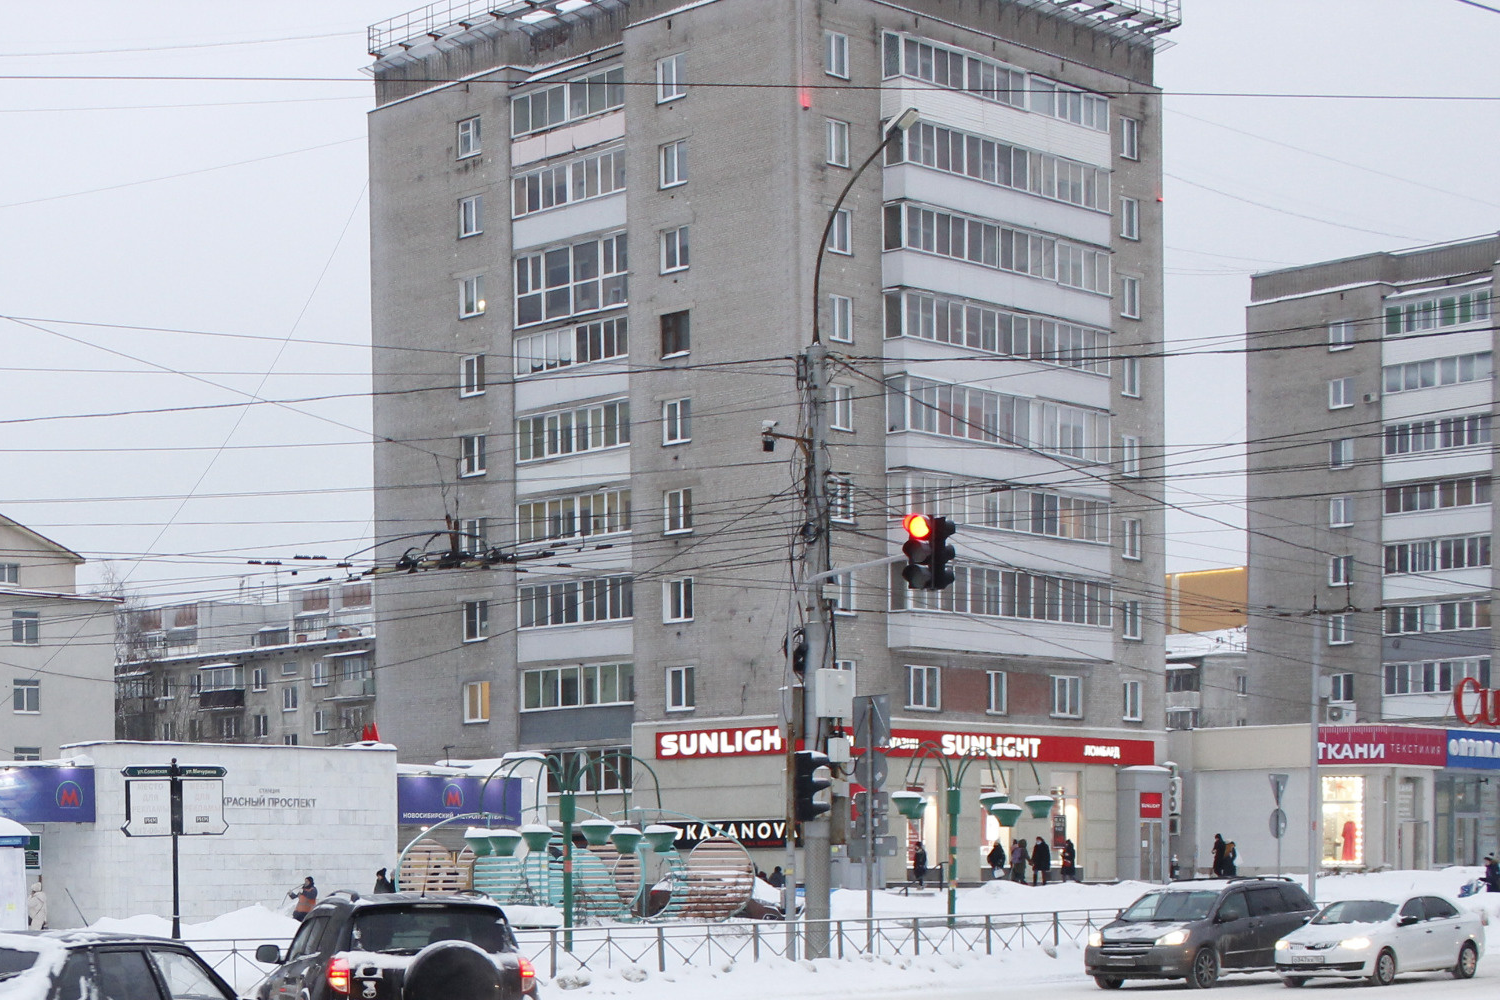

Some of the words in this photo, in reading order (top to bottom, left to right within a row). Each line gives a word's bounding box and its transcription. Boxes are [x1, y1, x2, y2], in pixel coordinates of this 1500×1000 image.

[941, 733, 1042, 759] SUNLIGHT
[1083, 745, 1121, 760] ЛОМБАРД
[1317, 742, 1385, 760] ТКАНИ
[1390, 743, 1441, 755] ТЕКСТИЛИЯ
[222, 795, 266, 807] КРАСНЫЙ
[268, 797, 317, 808] ПРОСПЕКТ
[402, 811, 444, 820] НОВОСИБИРСКИЙ
